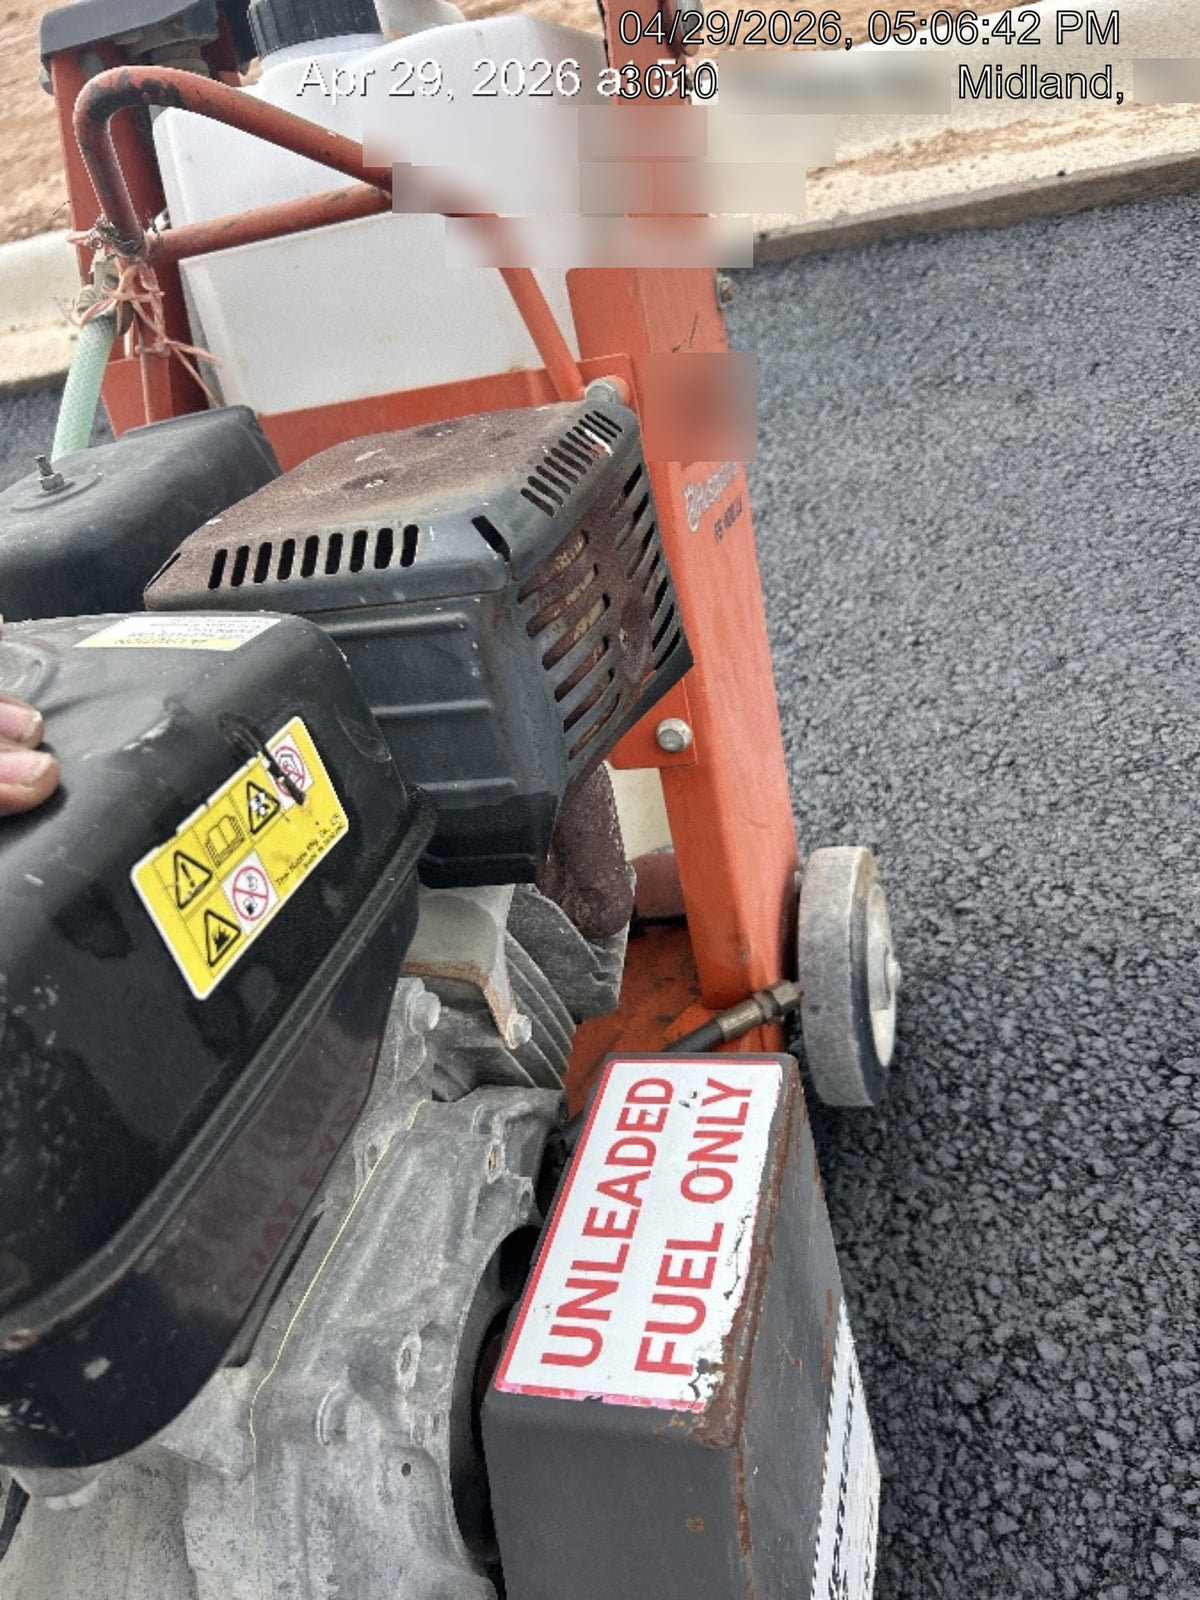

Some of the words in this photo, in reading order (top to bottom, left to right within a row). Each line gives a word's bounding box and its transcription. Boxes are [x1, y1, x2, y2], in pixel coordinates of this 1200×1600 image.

[541, 1077, 673, 1369] UNLEADED
[634, 1222, 725, 1377] FUEL
[680, 1077, 753, 1204] ONLY
